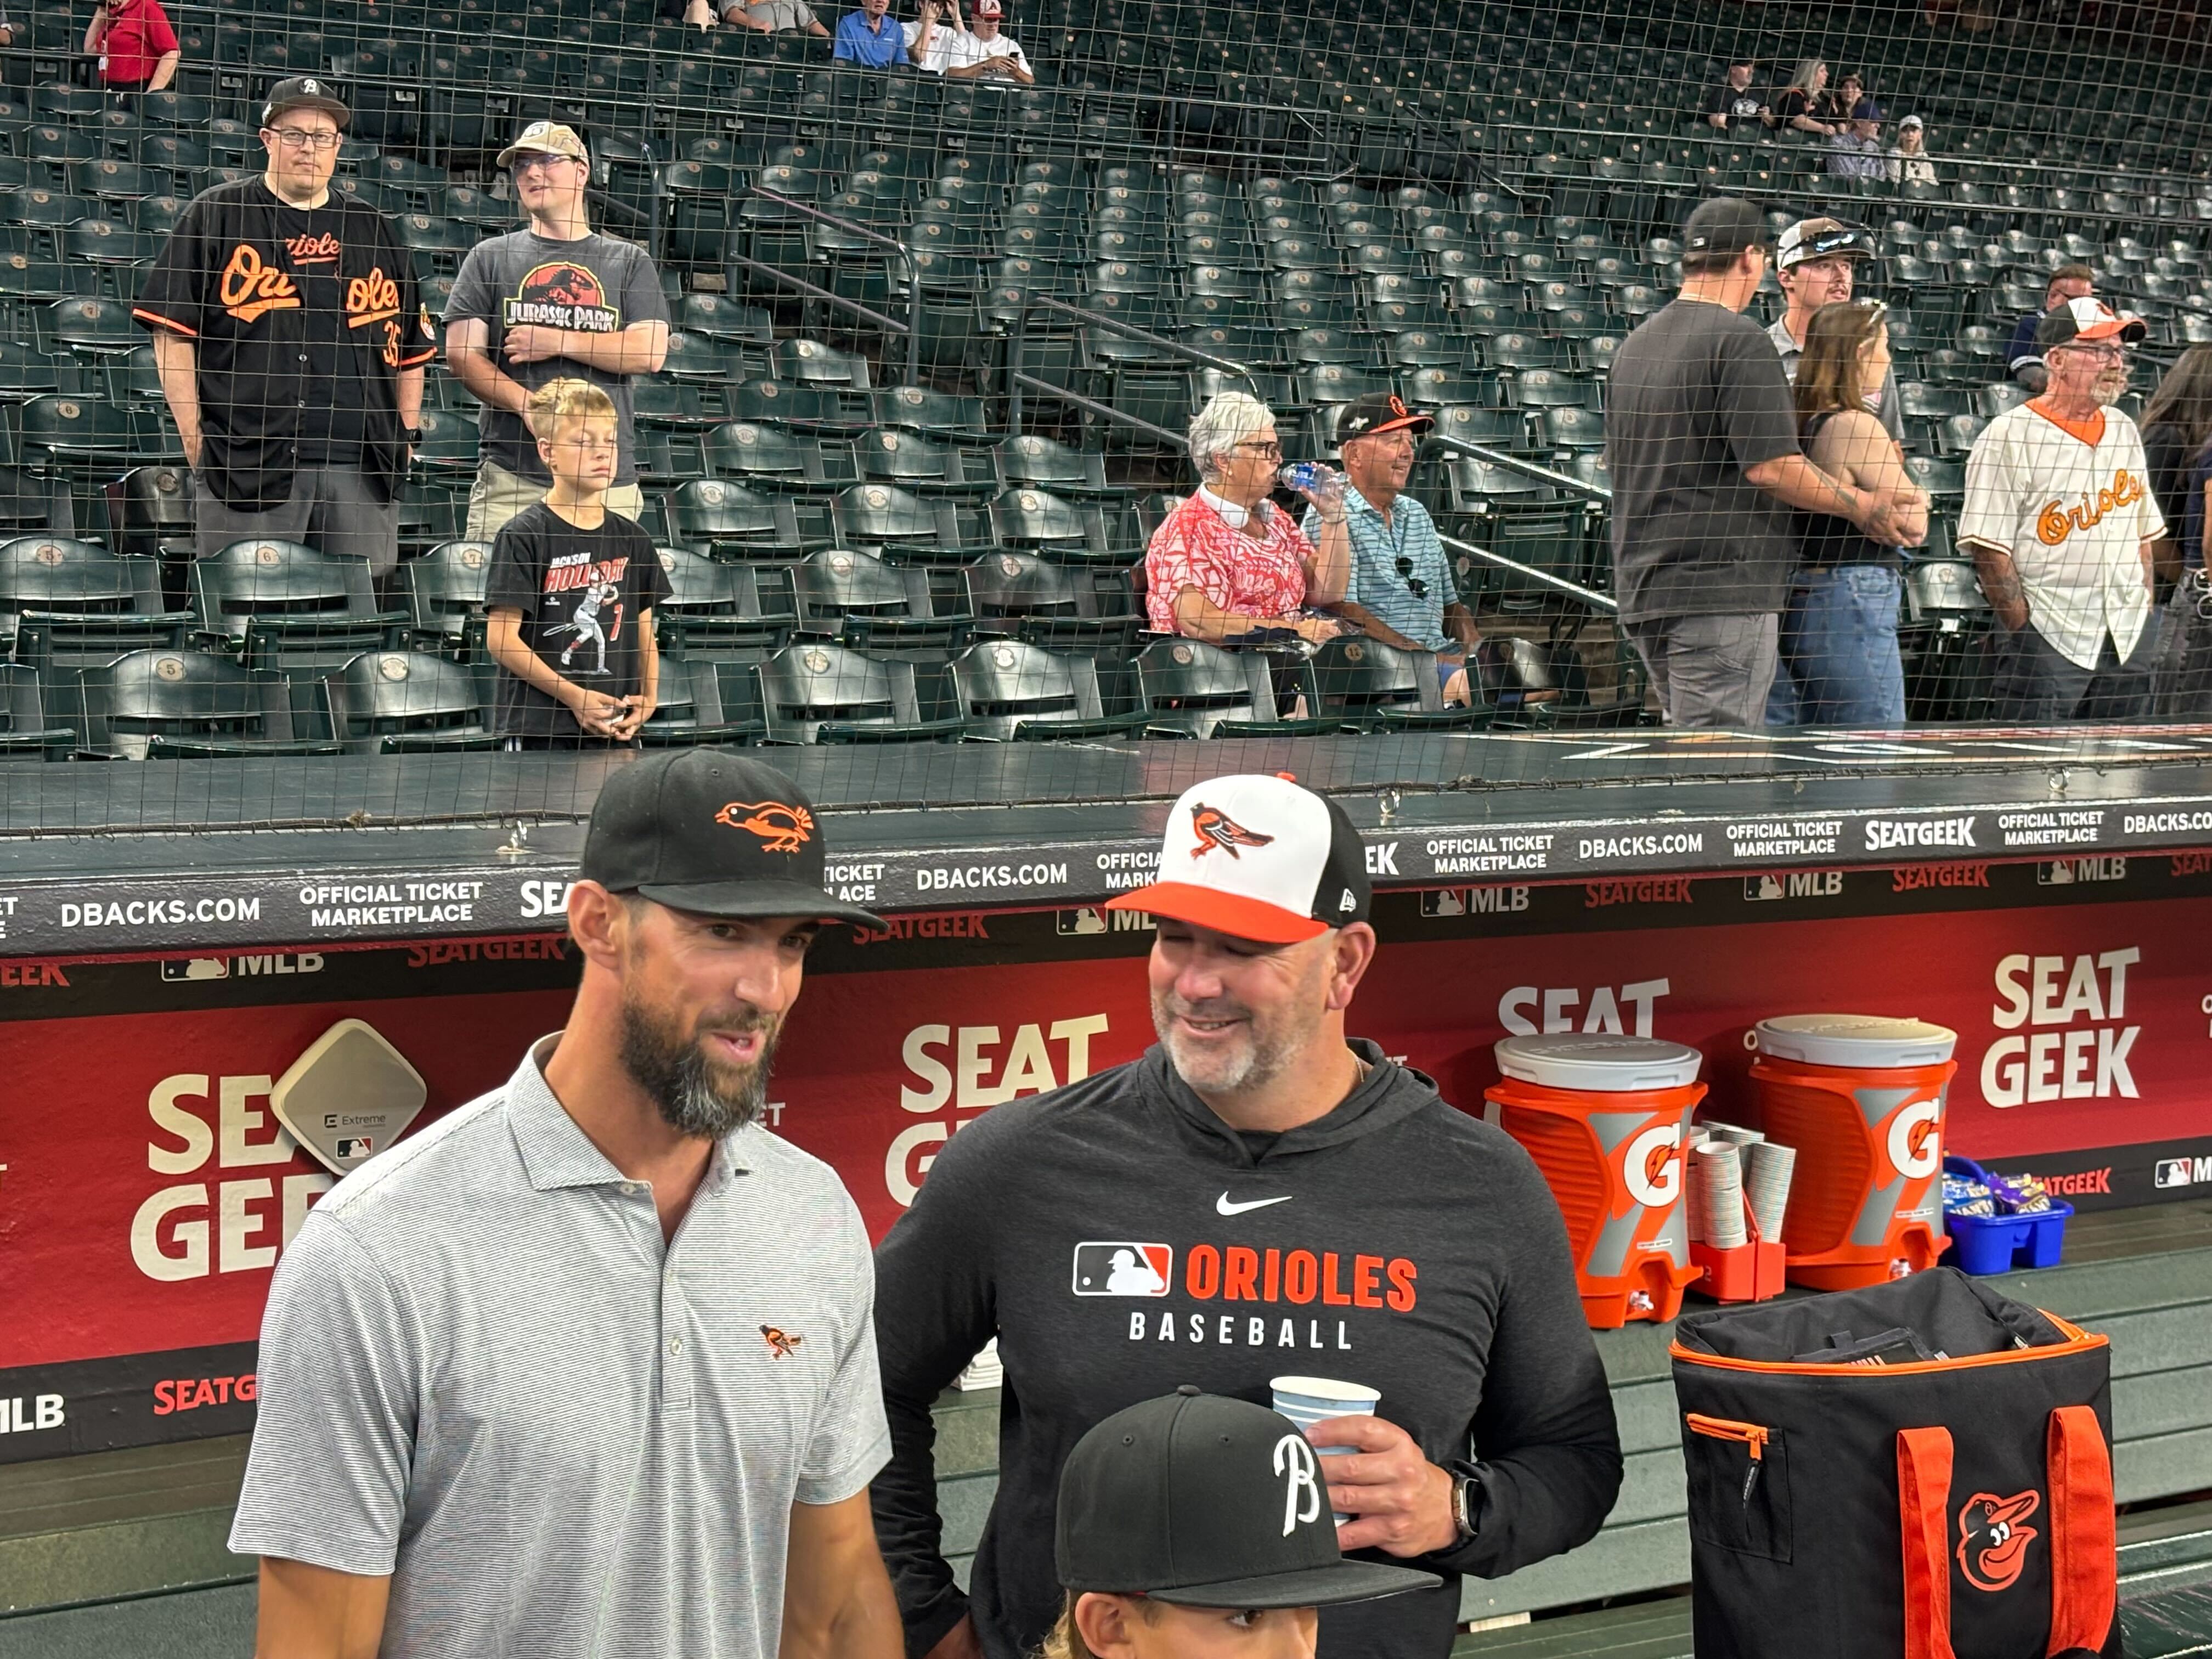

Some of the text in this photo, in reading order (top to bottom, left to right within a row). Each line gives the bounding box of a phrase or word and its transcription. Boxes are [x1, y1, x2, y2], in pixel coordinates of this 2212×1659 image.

[507, 302, 616, 332] JURASSIC PARK
[383, 320, 402, 368] 35
[423, 420, 430, 428] 8
[2037, 468, 2144, 546] Oriole
[263, 552, 271, 561] 6
[469, 554, 476, 563] 7
[550, 552, 591, 568] JACKSON
[167, 664, 175, 675] 5
[1726, 821, 1842, 839] OFFICIAL TICKET
[1866, 816, 1976, 851] SEATGEEK
[1999, 811, 2104, 830] OFFICIAL TICKET
[2124, 811, 2212, 834] DBACKS.CO
[1427, 835, 1554, 856] OFFICIAL TICKET
[1579, 833, 1702, 859] DBACKS.COM
[1734, 839, 1836, 857] MARKETPLACE
[2005, 828, 2098, 845] MARKETPLACE
[1097, 851, 1162, 870] OFFICIA
[1435, 854, 1547, 873] MARKETPLACE
[2078, 856, 2126, 882] MLB
[2171, 854, 2212, 876] SEAT
[917, 864, 1067, 890] DBACKS.COM
[1790, 871, 1843, 897] MLB
[1892, 865, 1990, 892] SEATGEEK
[300, 881, 483, 905] OFFICIAL TICKET
[1471, 886, 1529, 913] MLB
[1585, 879, 1694, 908] SEATGEEK
[61, 898, 259, 927] DBACKS.COM
[312, 905, 472, 927] MARKETPLACE
[1114, 909, 1157, 932] ML
[238, 953, 325, 976] MLB
[408, 937, 565, 968] SEATGEEK
[1993, 946, 2140, 1029] SEAT
[901, 1013, 1109, 1114] SEAT
[1980, 1026, 2141, 1109] GEEK
[148, 1074, 296, 1175] SE
[342, 1115, 386, 1126] Extreme
[1887, 1097, 1940, 1179] G
[1623, 1122, 1680, 1207] G
[2033, 1167, 2112, 1196] ATGEEK
[1186, 1244, 1418, 1313] ORIOLES
[1129, 1312, 1352, 1350] BASEBALL
[153, 1374, 256, 1415] SEATG
[1273, 1434, 1320, 1537] B
